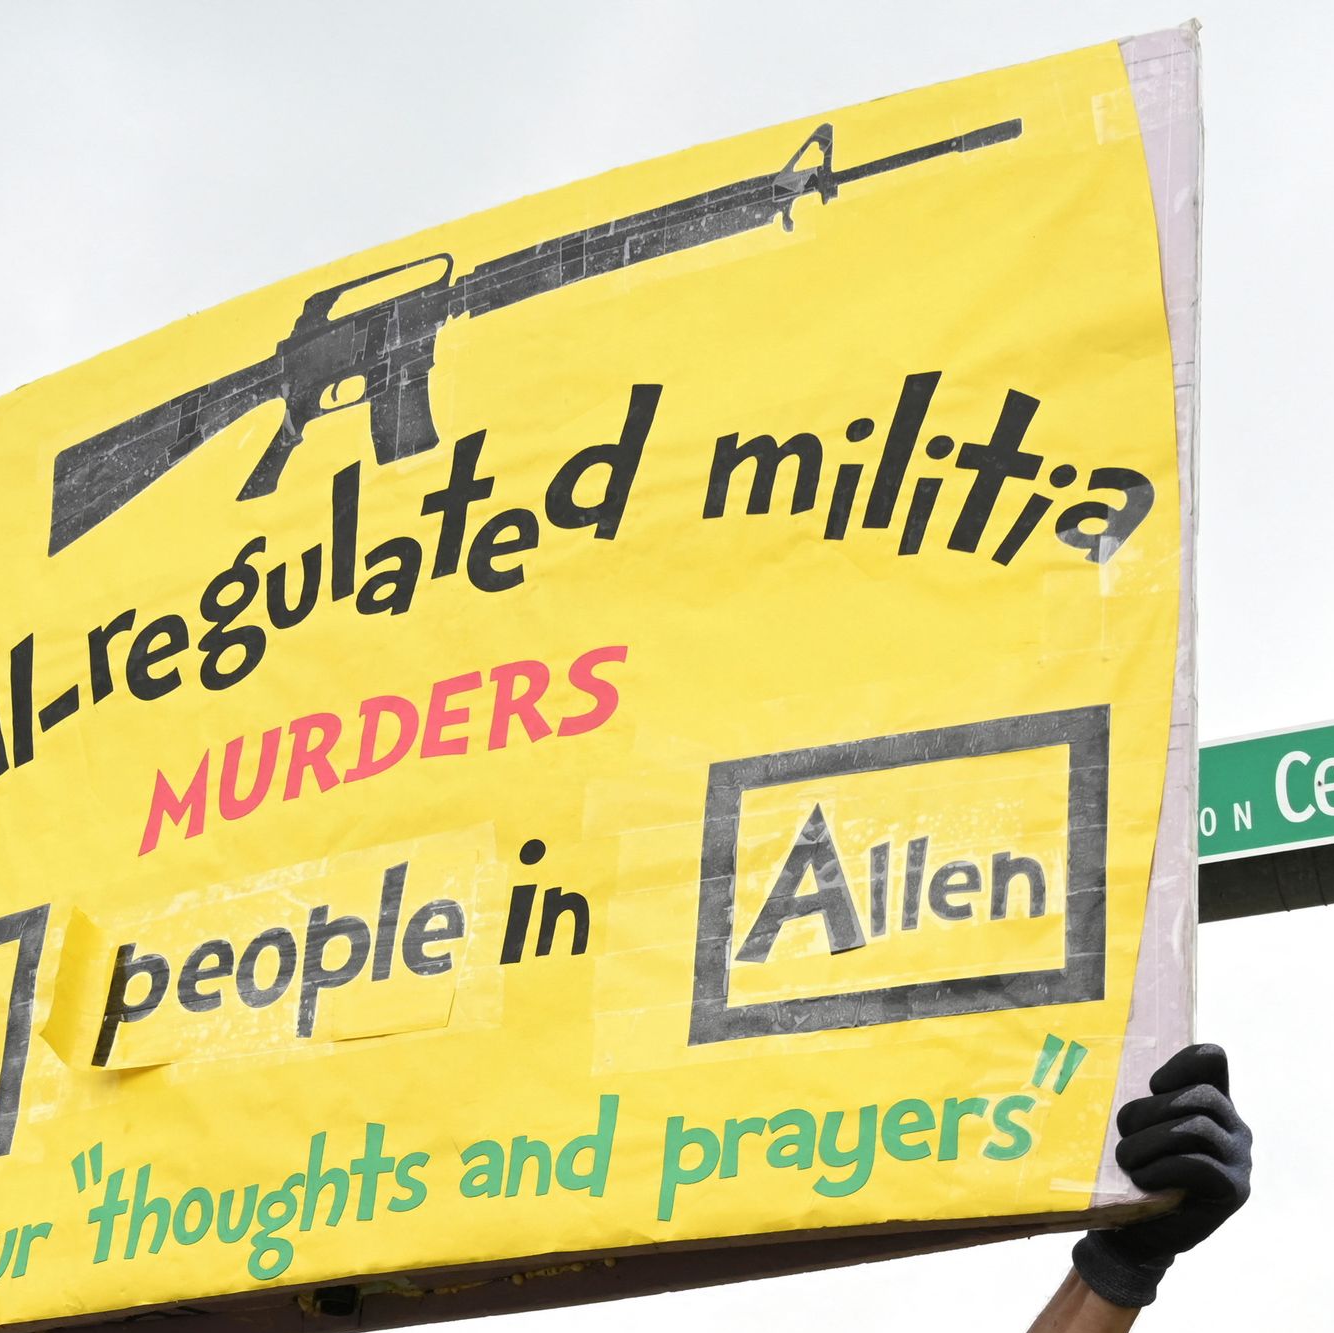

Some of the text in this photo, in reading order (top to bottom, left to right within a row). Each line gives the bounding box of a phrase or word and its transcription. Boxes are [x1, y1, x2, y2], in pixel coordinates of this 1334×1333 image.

[702, 370, 1155, 567] militia
[138, 645, 628, 856] MURDERS
[1233, 800, 1253, 832] N
[91, 861, 465, 1067] people
[499, 838, 590, 965] in
[735, 803, 1046, 963] Allen
[71, 1122, 430, 1280] "thoughts
[460, 1094, 619, 1199] and
[657, 1033, 1088, 1222] prayers"
